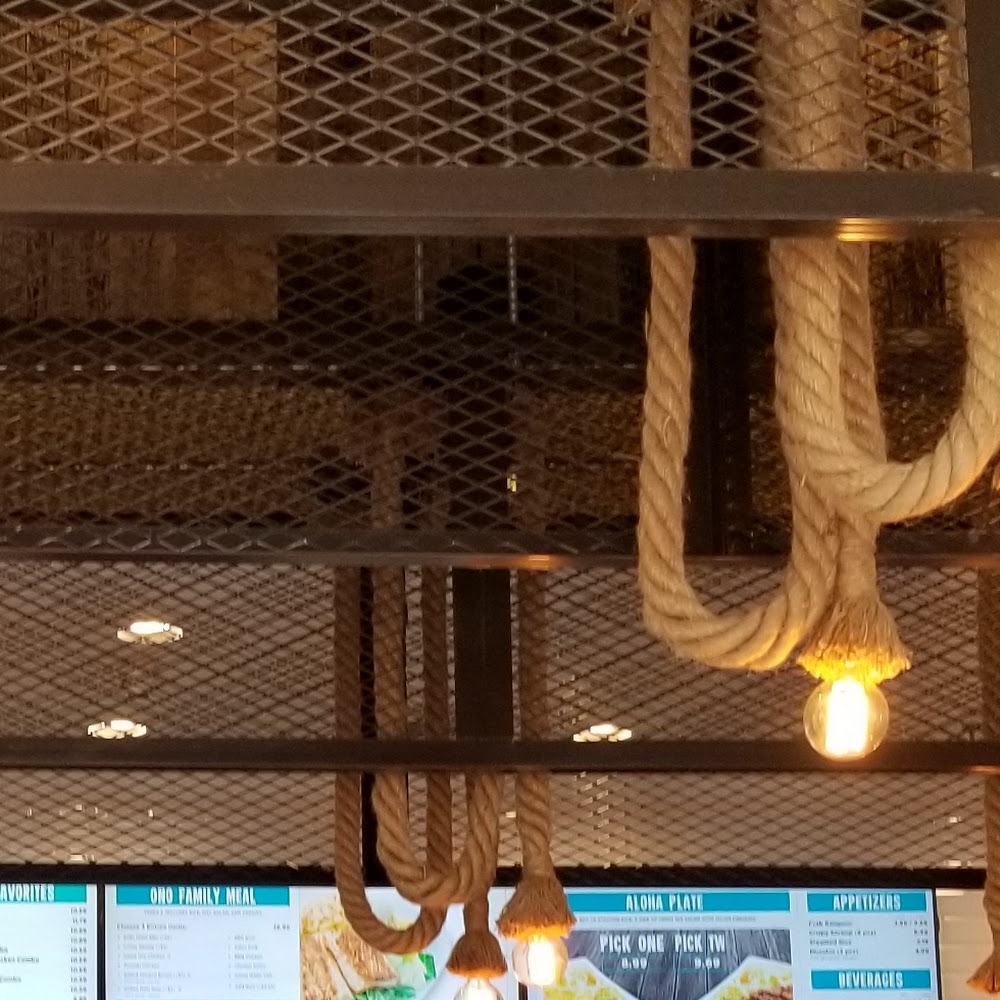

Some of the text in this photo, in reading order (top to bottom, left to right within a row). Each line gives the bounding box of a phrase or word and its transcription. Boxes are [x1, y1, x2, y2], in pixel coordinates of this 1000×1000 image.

[150, 887, 257, 906] ONO FAMILY MEAL
[626, 894, 704, 911] ALOHA PLATE
[833, 894, 902, 912] APPETIZERS
[600, 934, 664, 953] PICK ONE
[675, 934, 704, 953] PICK
[838, 971, 904, 989] BEVERAGES
